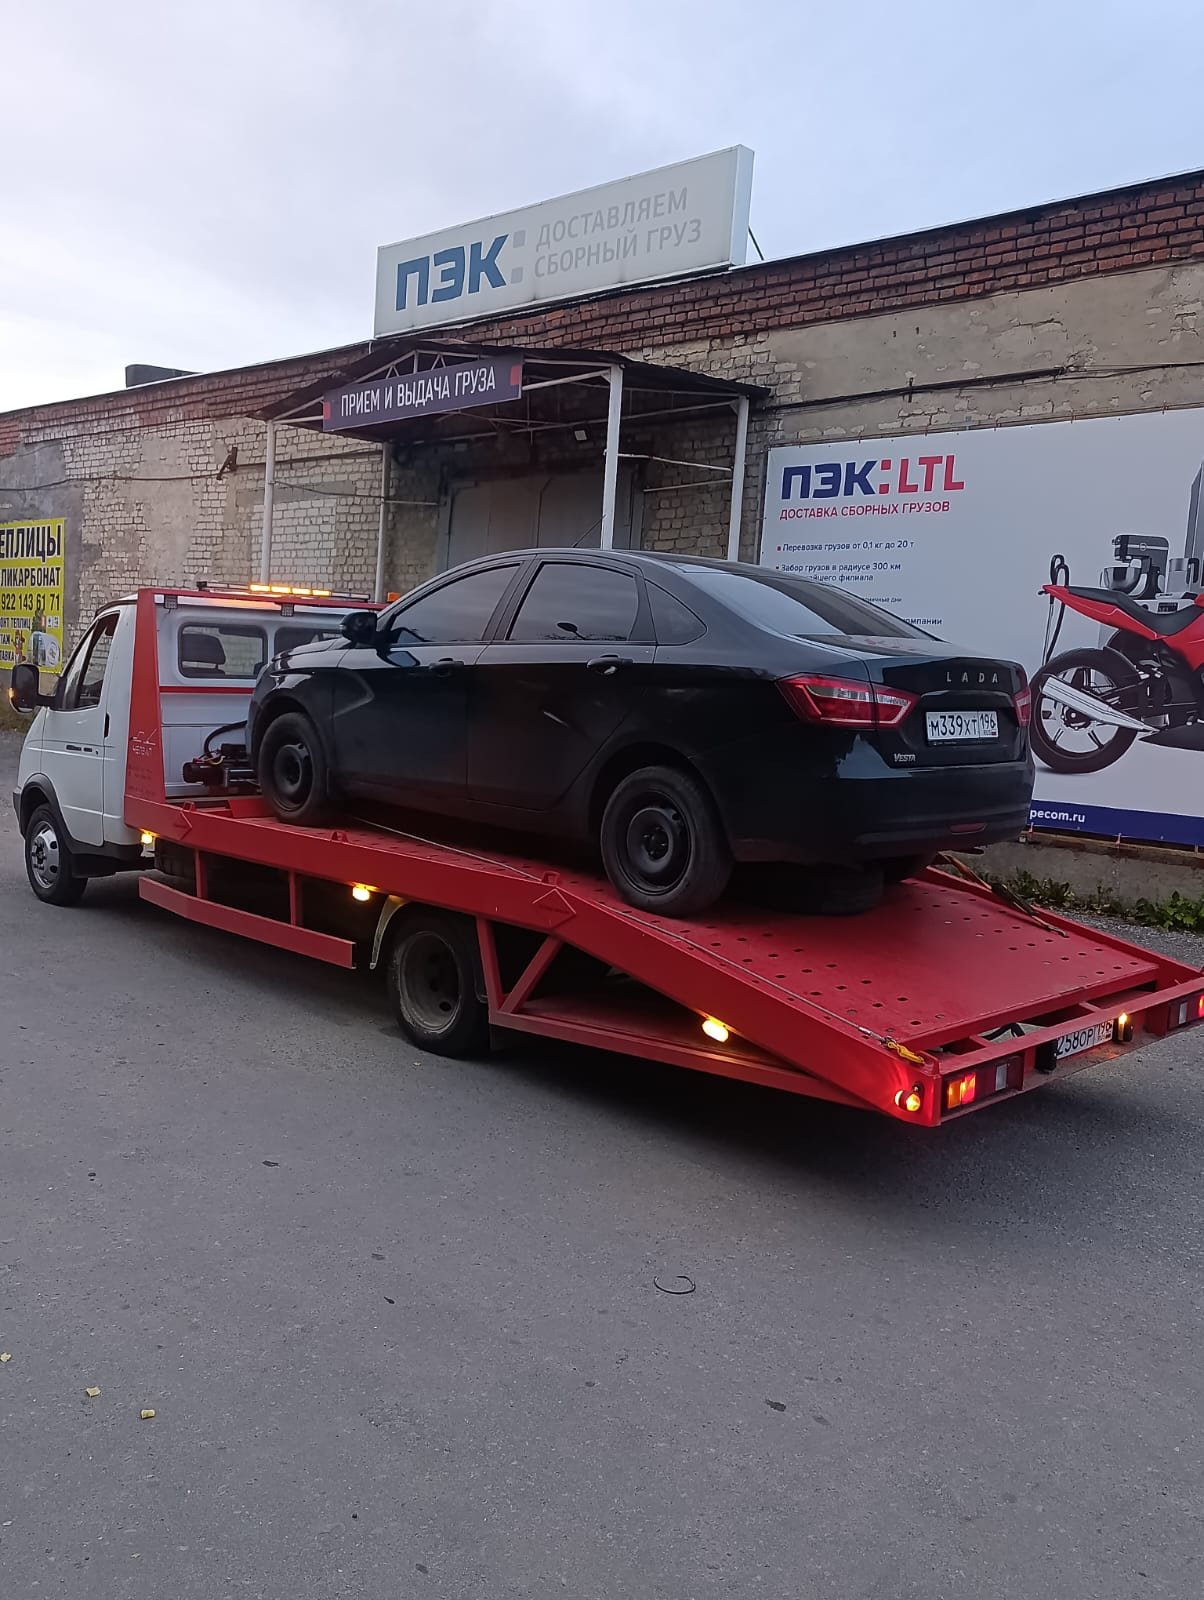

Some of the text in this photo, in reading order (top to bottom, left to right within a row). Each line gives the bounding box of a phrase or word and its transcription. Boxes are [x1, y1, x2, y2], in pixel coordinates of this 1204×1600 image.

[535, 187, 688, 252] ДОСТАВЛЯЕМ
[534, 218, 702, 278] СБОРНЫЙ ГРУЗ
[341, 366, 496, 417] ПРИЕМ И ВЫДАЧА ГРУЗА
[780, 501, 950, 521] ДОСТАВКА СБОРНЫХ ГРУЗОВ
[782, 543, 822, 552] Перевозка
[824, 543, 850, 551] грузов
[862, 541, 873, 550] 0,1
[885, 542, 895, 550] до
[897, 540, 908, 548] 20
[782, 564, 804, 572] Забор
[805, 564, 830, 572] грузов
[839, 563, 871, 572] радиусе
[872, 562, 889, 570] 300
[1, 567, 61, 587] ЛИКАРБОНАТ
[838, 573, 874, 583] филиала
[1, 593, 60, 610] 922 143 61 71
[946, 671, 998, 683] LADA
[930, 713, 996, 737] М339ХТ 196
[1029, 808, 1086, 823] pecom.ru
